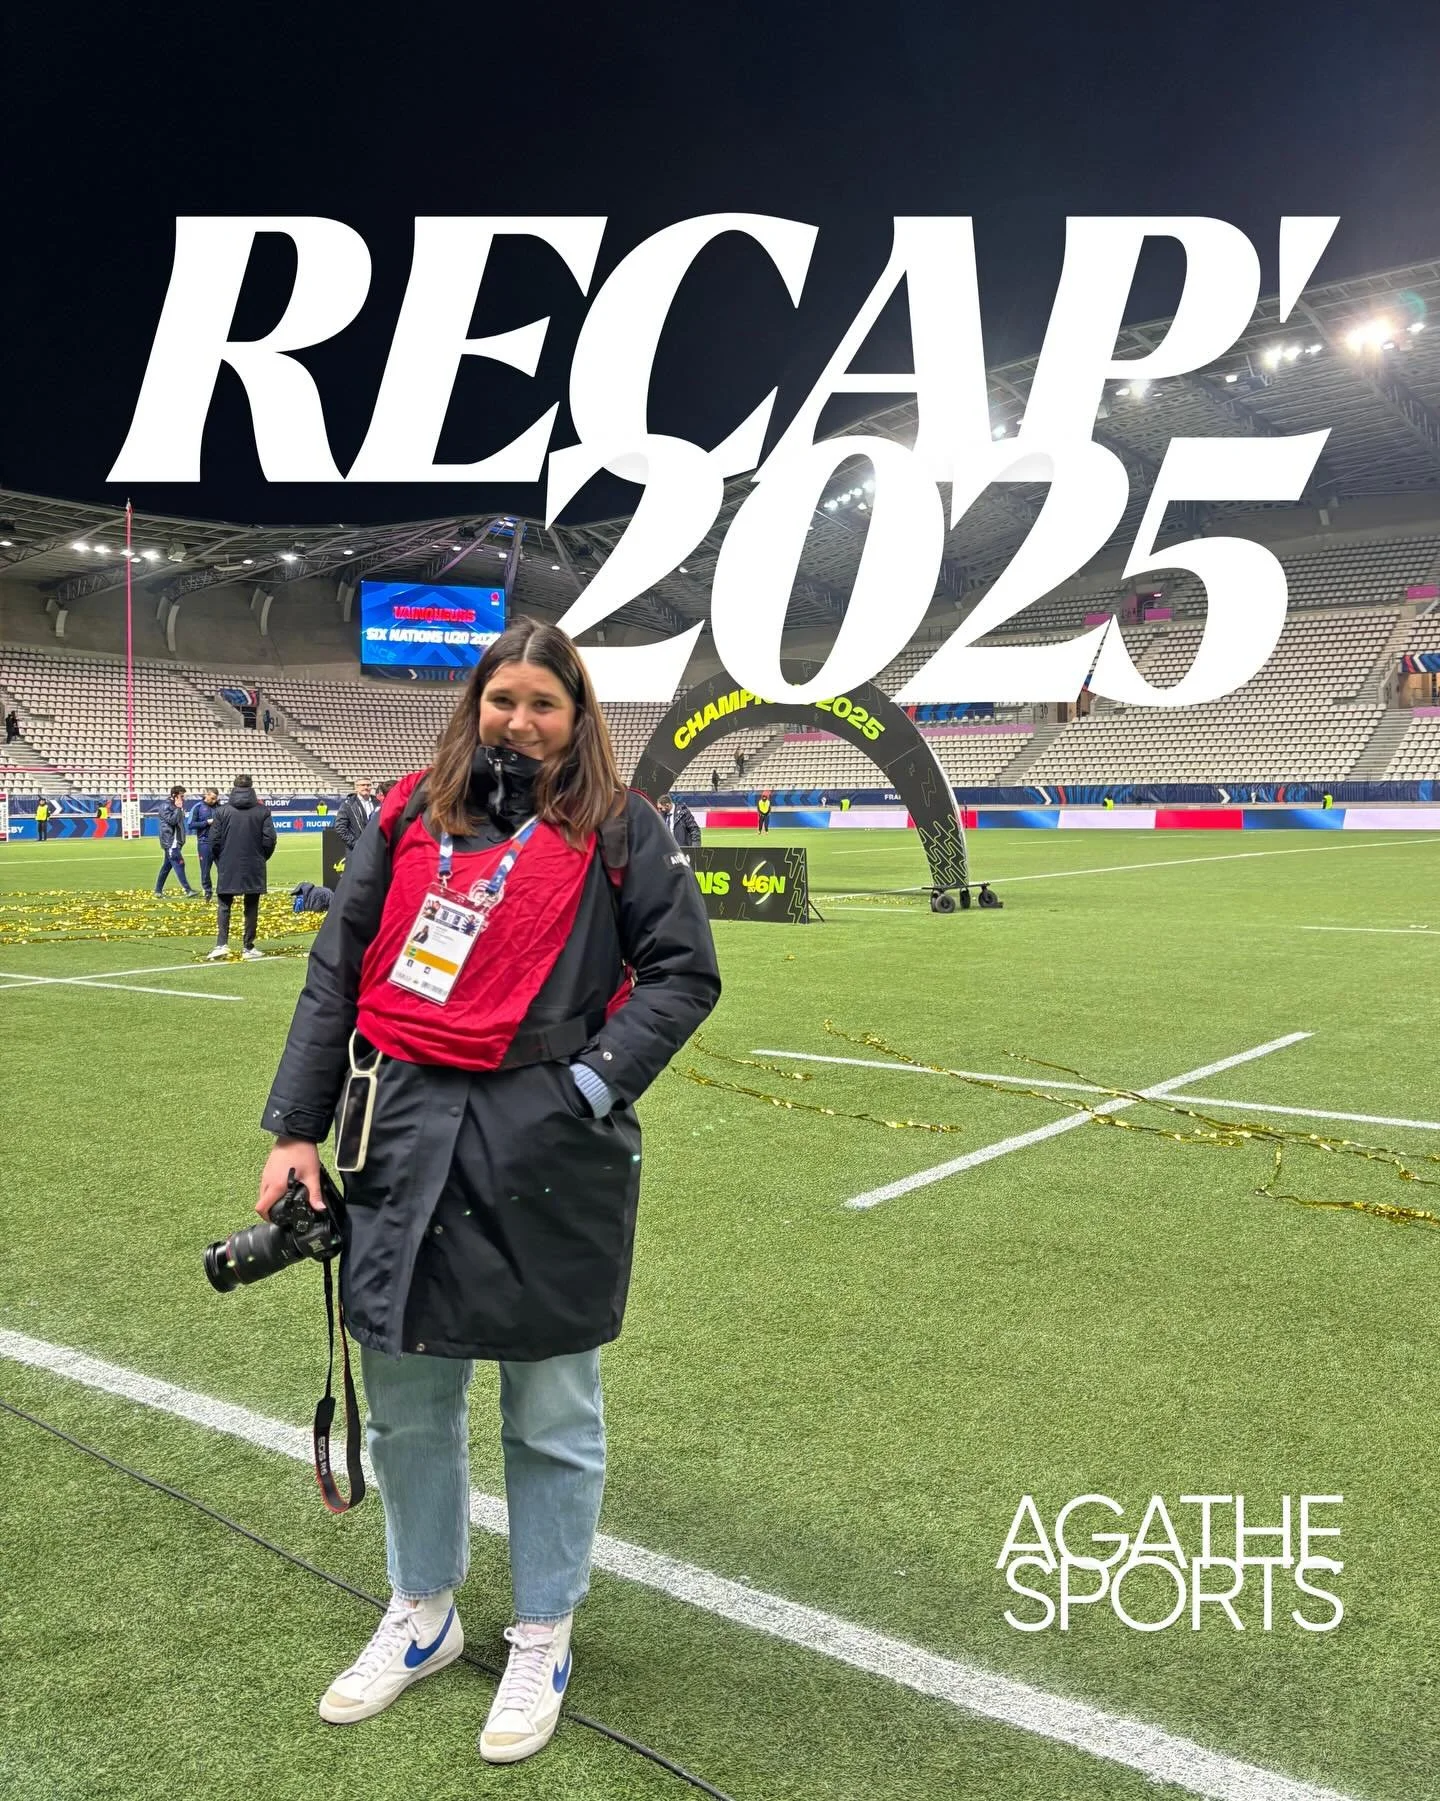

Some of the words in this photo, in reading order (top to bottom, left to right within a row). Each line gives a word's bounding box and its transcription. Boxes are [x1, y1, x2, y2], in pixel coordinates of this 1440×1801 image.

[393, 605, 476, 623] VAINQUEURS
[366, 627, 388, 641] SIX
[389, 629, 443, 644] NATIONS
[445, 631, 470, 645] U20
[814, 696, 886, 741] 2025
[265, 799, 290, 807] RUGBY
[306, 820, 331, 828] RUGBY
